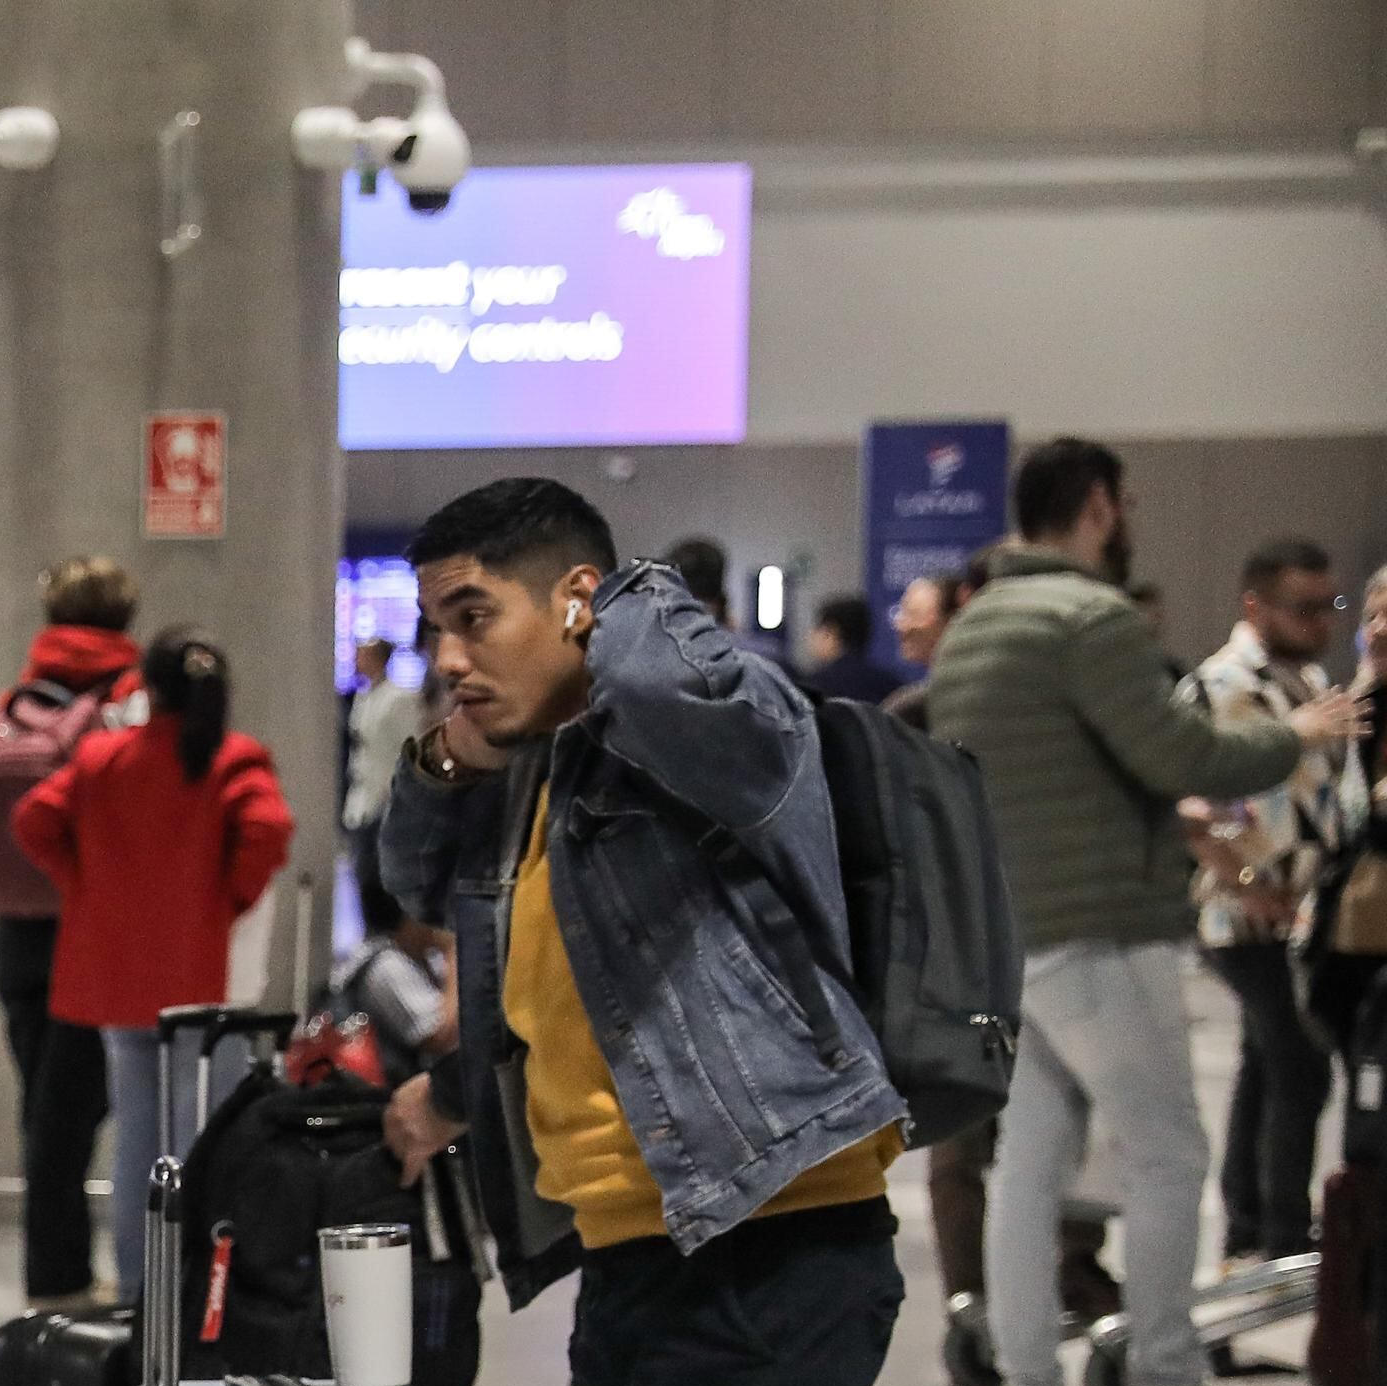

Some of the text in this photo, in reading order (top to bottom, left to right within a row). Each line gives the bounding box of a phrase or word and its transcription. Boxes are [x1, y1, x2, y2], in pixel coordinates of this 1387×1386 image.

[339, 261, 567, 315] resent your
[338, 311, 624, 373] ecurity controls
